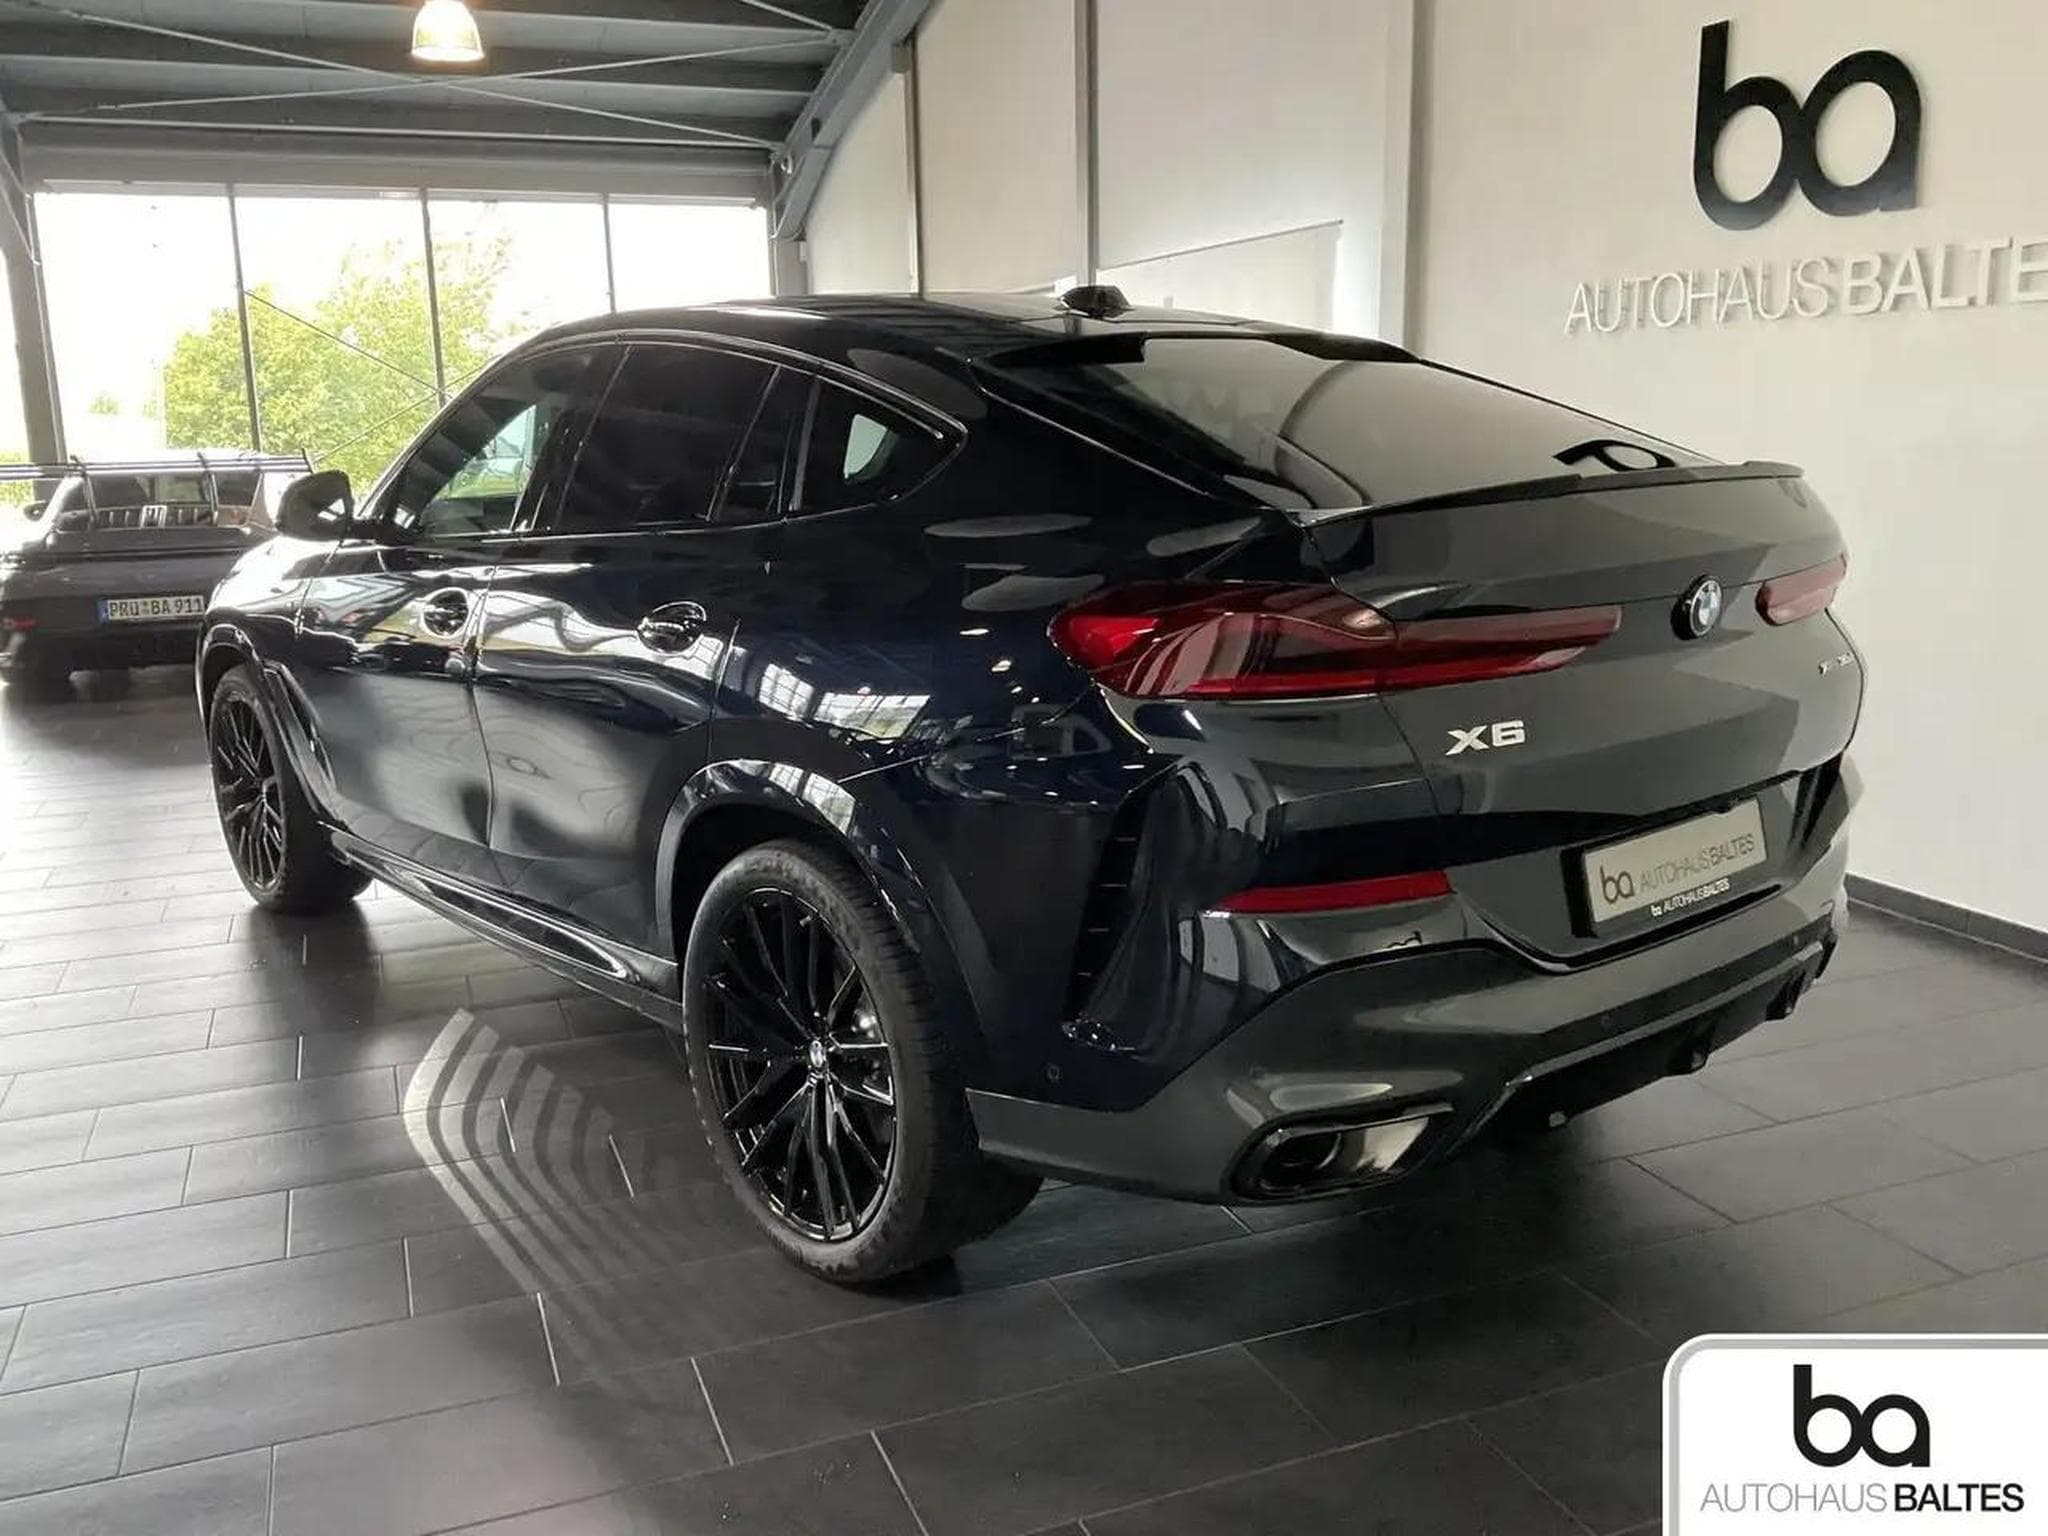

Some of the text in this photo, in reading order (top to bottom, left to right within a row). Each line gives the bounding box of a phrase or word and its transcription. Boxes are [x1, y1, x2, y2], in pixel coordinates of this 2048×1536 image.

[1693, 20, 1922, 231] ba
[1445, 719, 1526, 756] X6
[1600, 865, 1636, 904] ba
